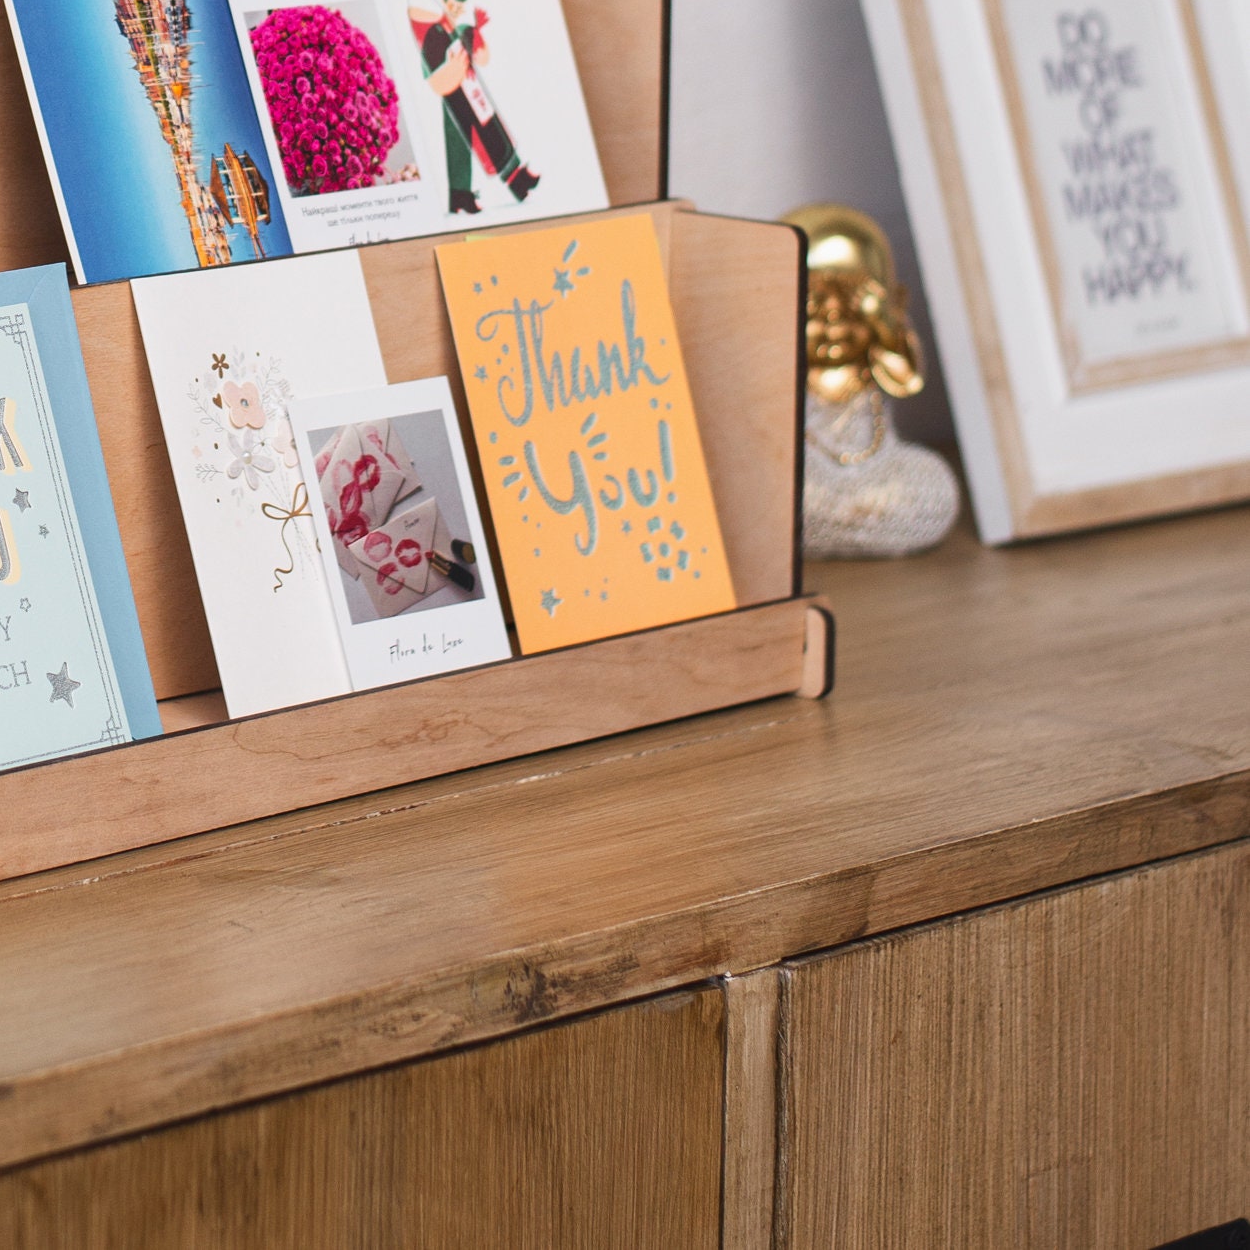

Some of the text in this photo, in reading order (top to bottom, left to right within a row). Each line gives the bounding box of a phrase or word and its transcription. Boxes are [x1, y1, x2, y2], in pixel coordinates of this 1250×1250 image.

[1055, 8, 1111, 52] DO
[1040, 45, 1145, 96] MORE
[1077, 92, 1121, 136] OF
[1059, 126, 1153, 174] WHAT
[1060, 166, 1183, 224] MAKES
[1092, 209, 1169, 258] YOU
[475, 278, 672, 427] Thank
[523, 419, 676, 556] You!
